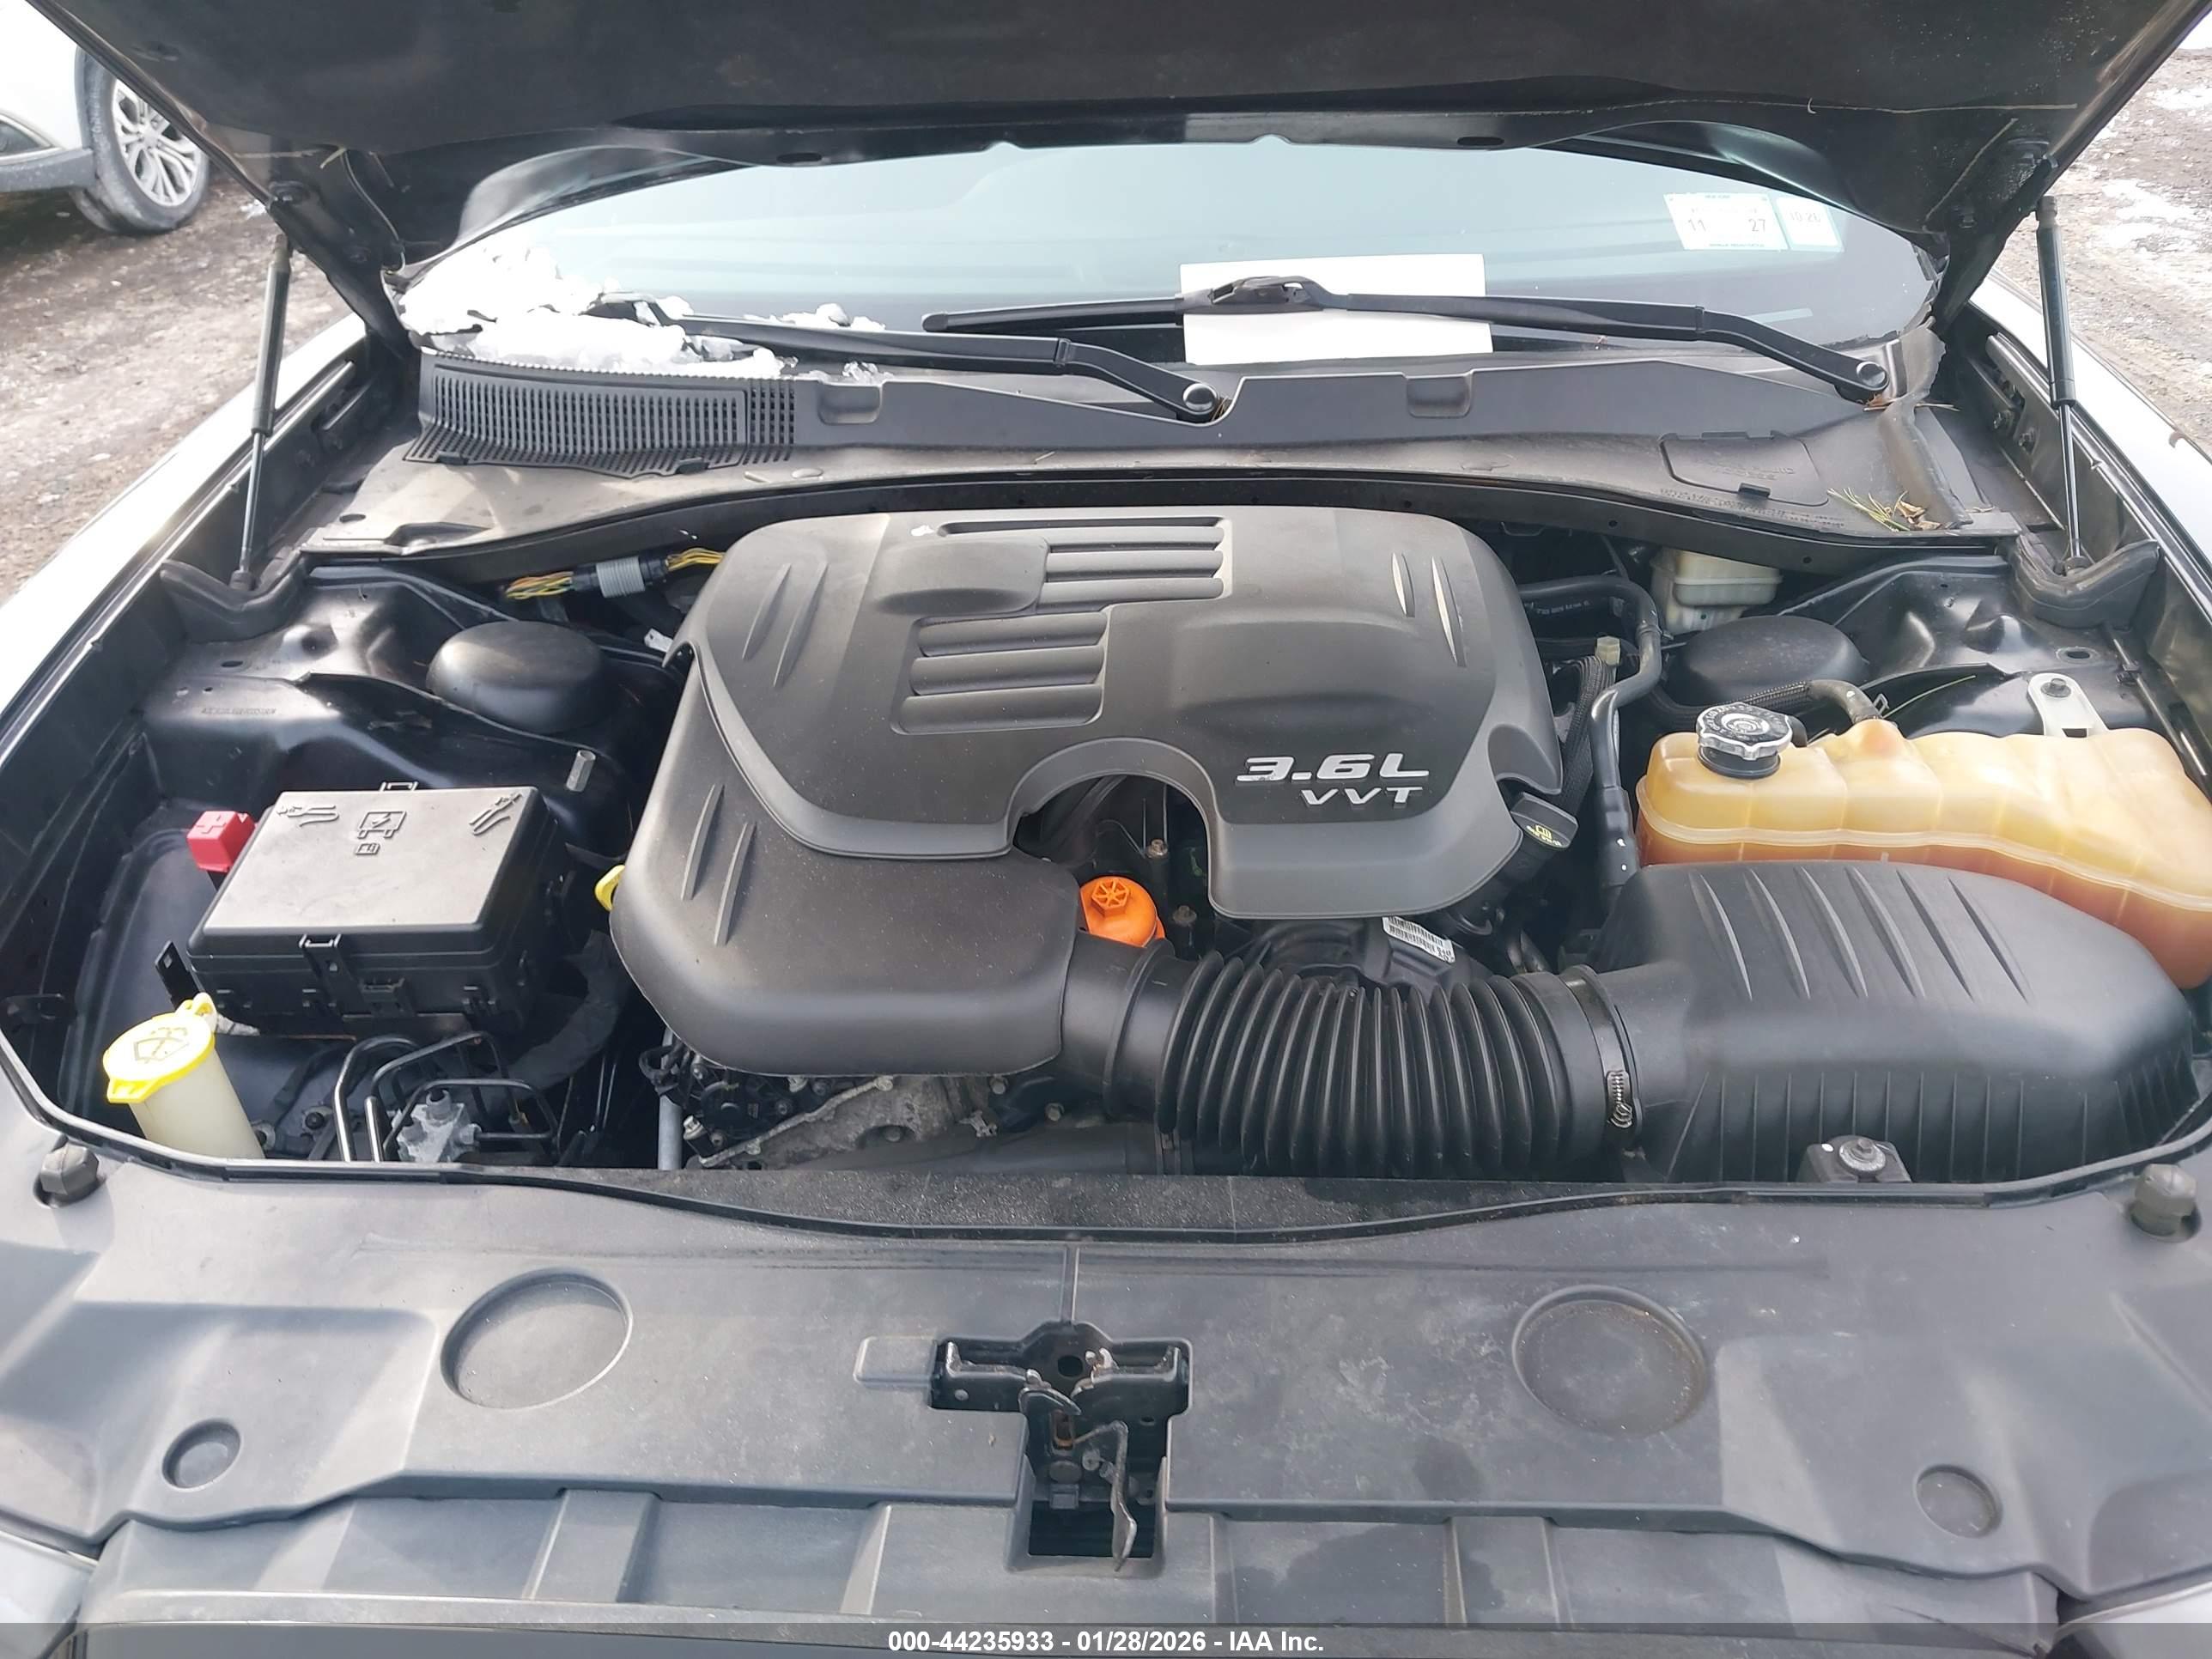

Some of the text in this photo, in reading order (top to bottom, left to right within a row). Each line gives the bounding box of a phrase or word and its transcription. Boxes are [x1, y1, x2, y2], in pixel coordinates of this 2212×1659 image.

[1747, 218, 1766, 233] 27
[1237, 753, 1431, 782] 3.6L
[1300, 786, 1424, 807] VVT
